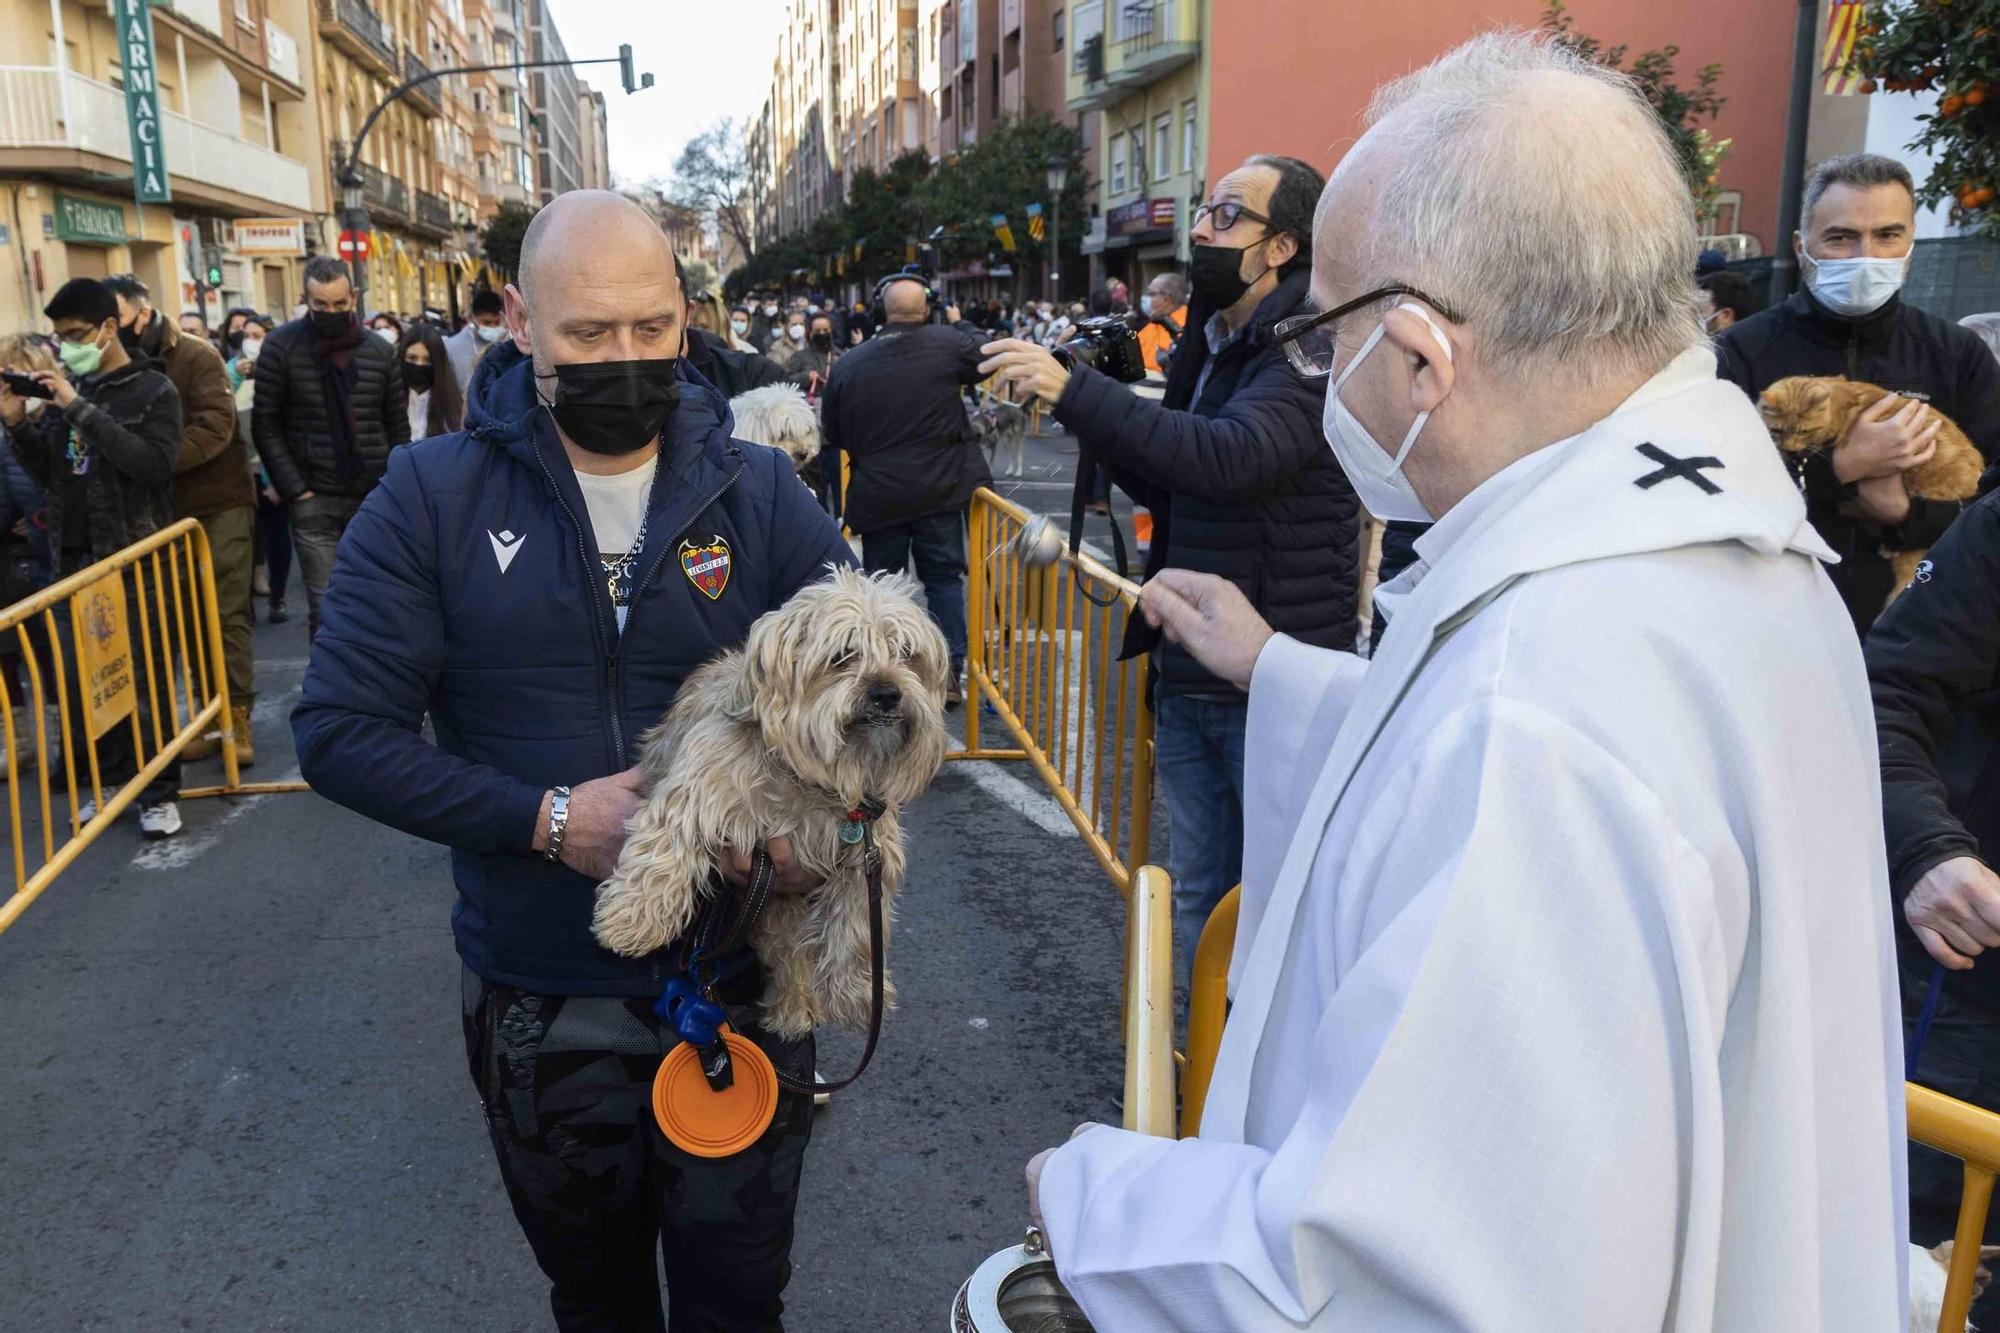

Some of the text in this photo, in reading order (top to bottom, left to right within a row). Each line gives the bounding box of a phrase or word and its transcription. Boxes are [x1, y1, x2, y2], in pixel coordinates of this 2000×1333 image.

[126, 0, 162, 193] FARMACIA
[74, 203, 123, 237] FARMACIA
[690, 561, 714, 575] LEVANTE
